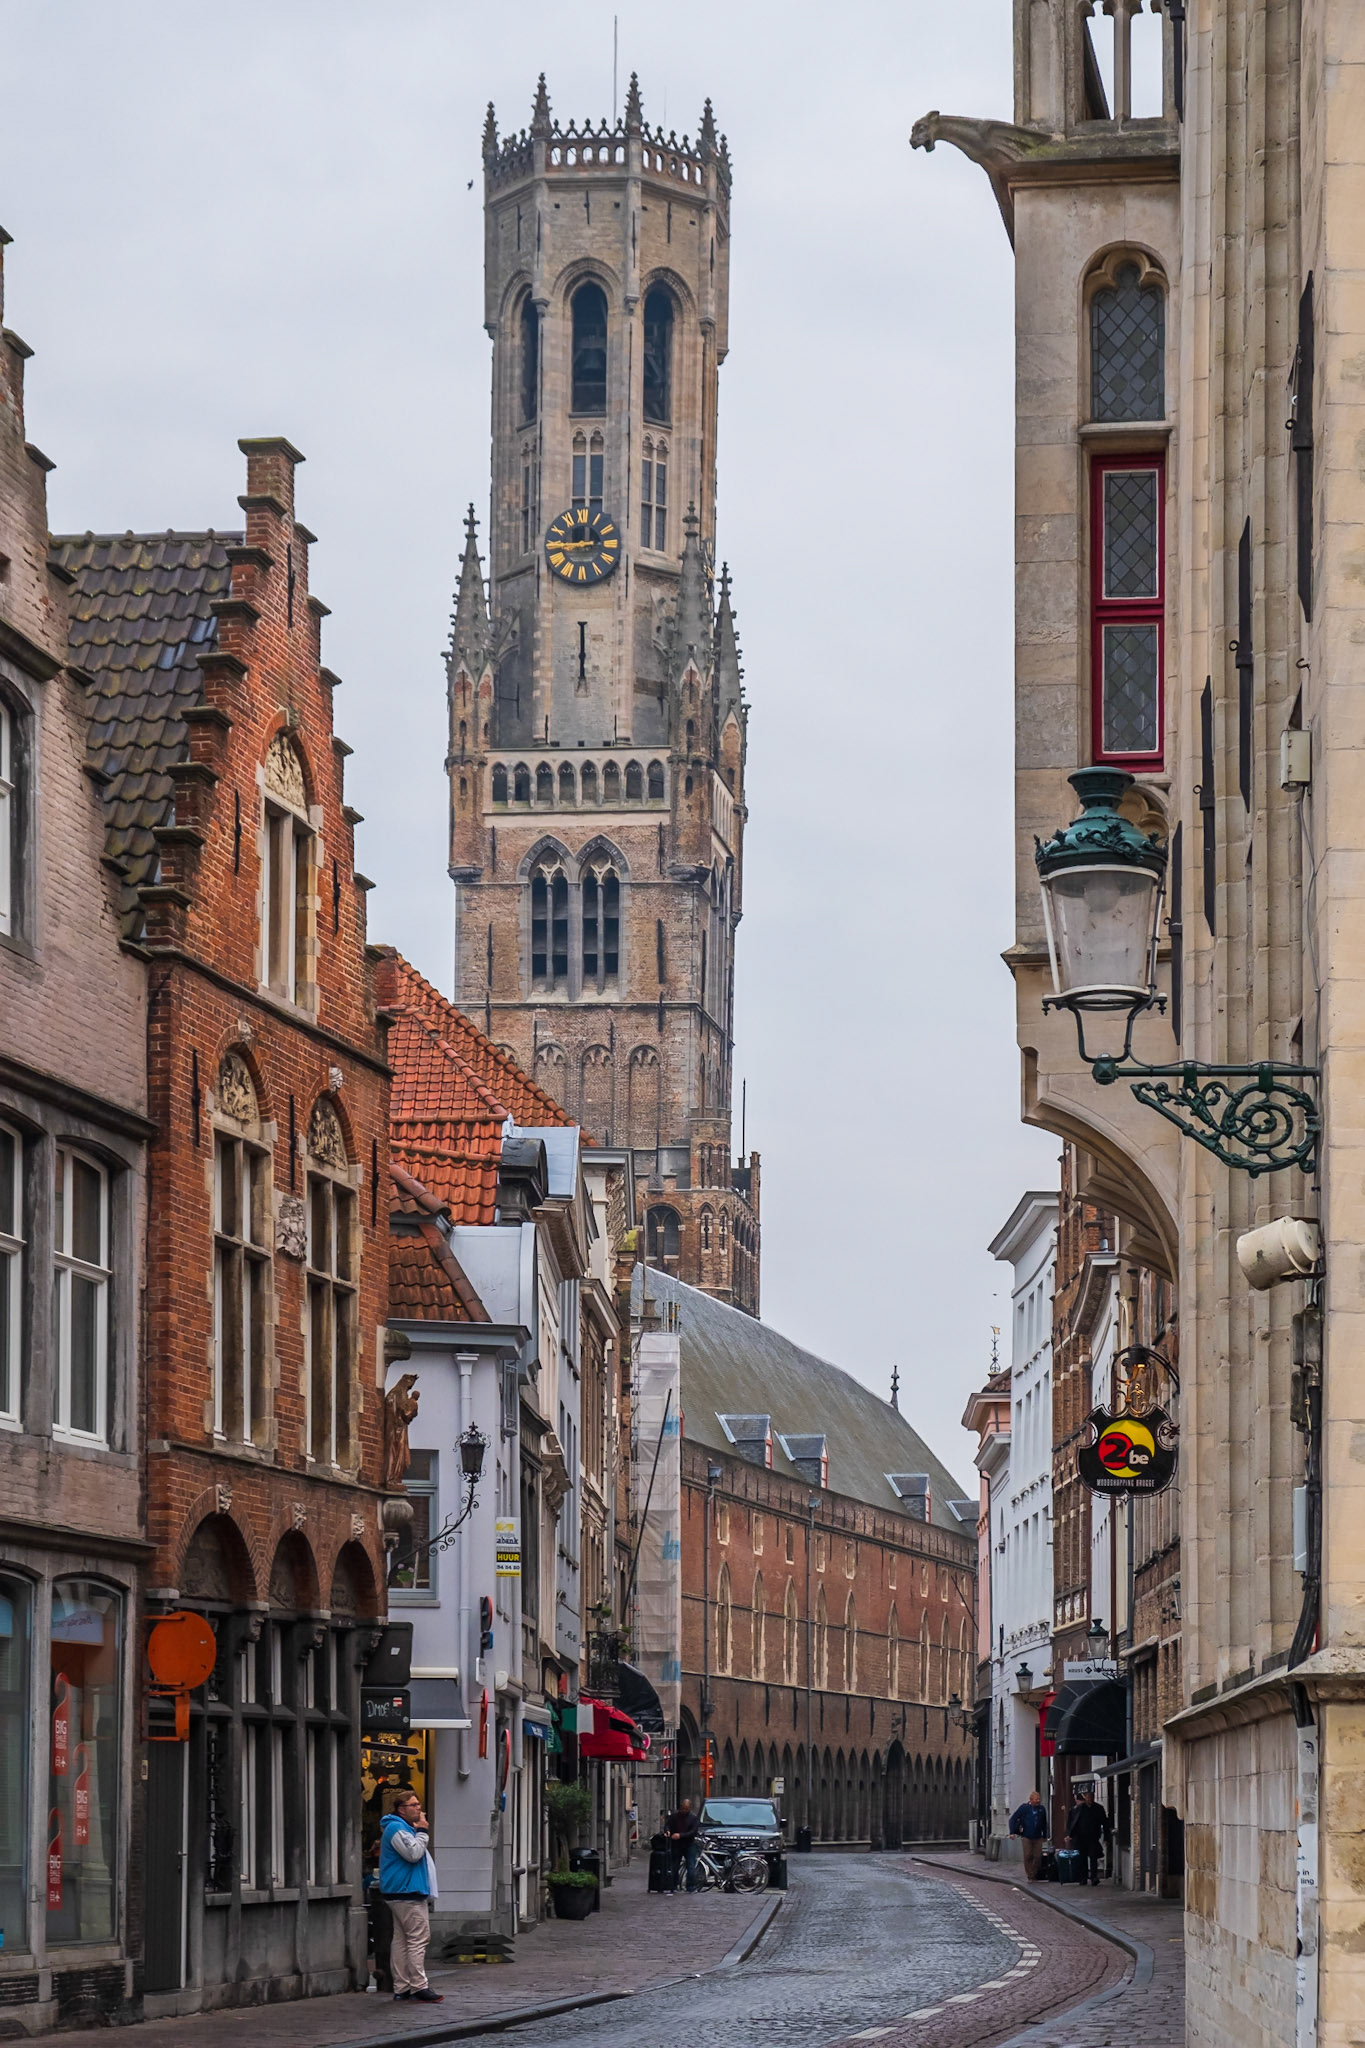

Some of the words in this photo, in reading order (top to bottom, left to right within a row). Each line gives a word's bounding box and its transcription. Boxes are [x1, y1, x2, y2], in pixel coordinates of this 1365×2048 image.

[1103, 1438, 1149, 1465] 2be
[55, 1720, 68, 1734] BIG
[77, 1790, 88, 1804] BIG
[50, 1855, 61, 1869] BIG
